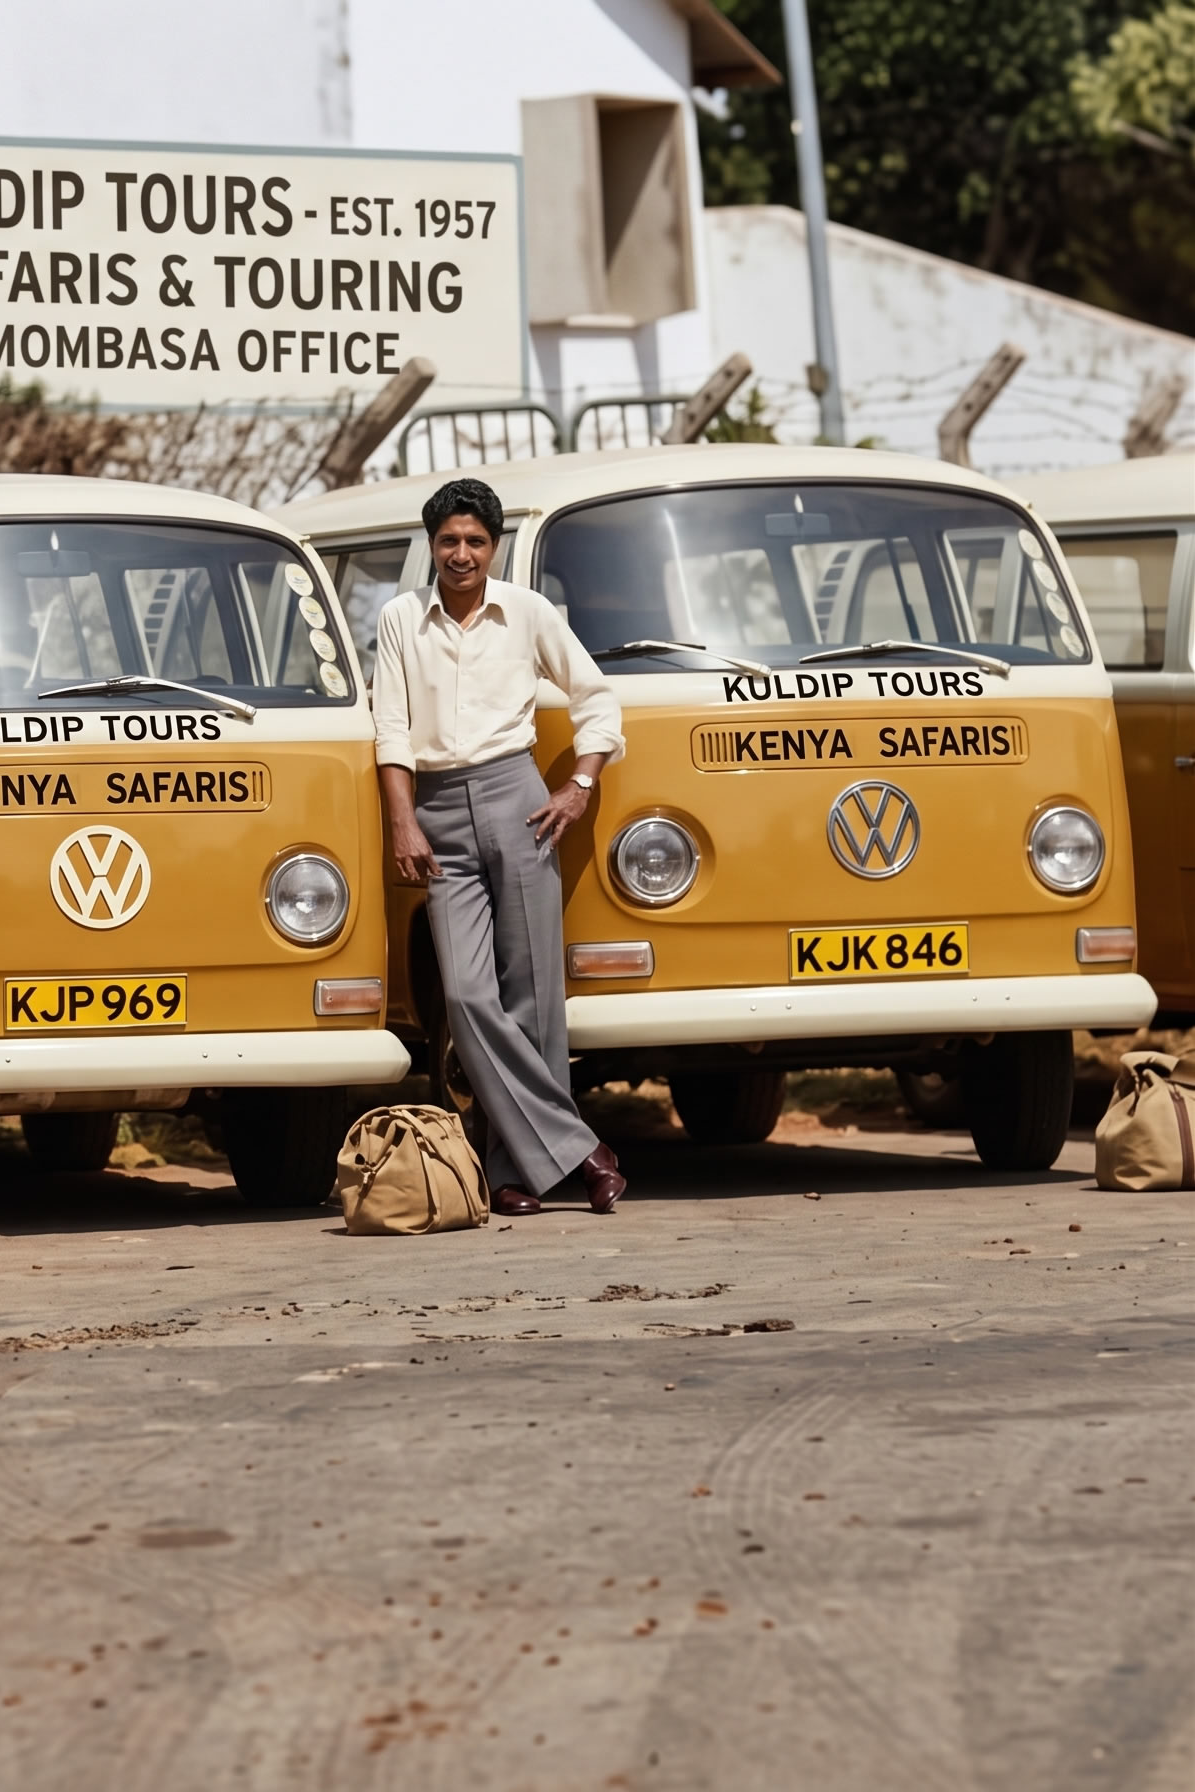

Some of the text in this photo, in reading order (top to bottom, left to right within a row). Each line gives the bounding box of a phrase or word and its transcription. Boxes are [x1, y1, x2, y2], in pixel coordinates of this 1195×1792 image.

[105, 172, 293, 238] TOURS
[330, 196, 402, 237] EST.
[414, 199, 497, 239] 1957
[159, 254, 196, 308] &
[213, 255, 463, 314] TOURING
[237, 329, 401, 376] OFFICE
[722, 671, 984, 703] KULDIP TOURS
[100, 714, 221, 741] TOURS
[735, 725, 1010, 762] KENYA SAFARIS
[106, 770, 249, 804] SAFARIS
